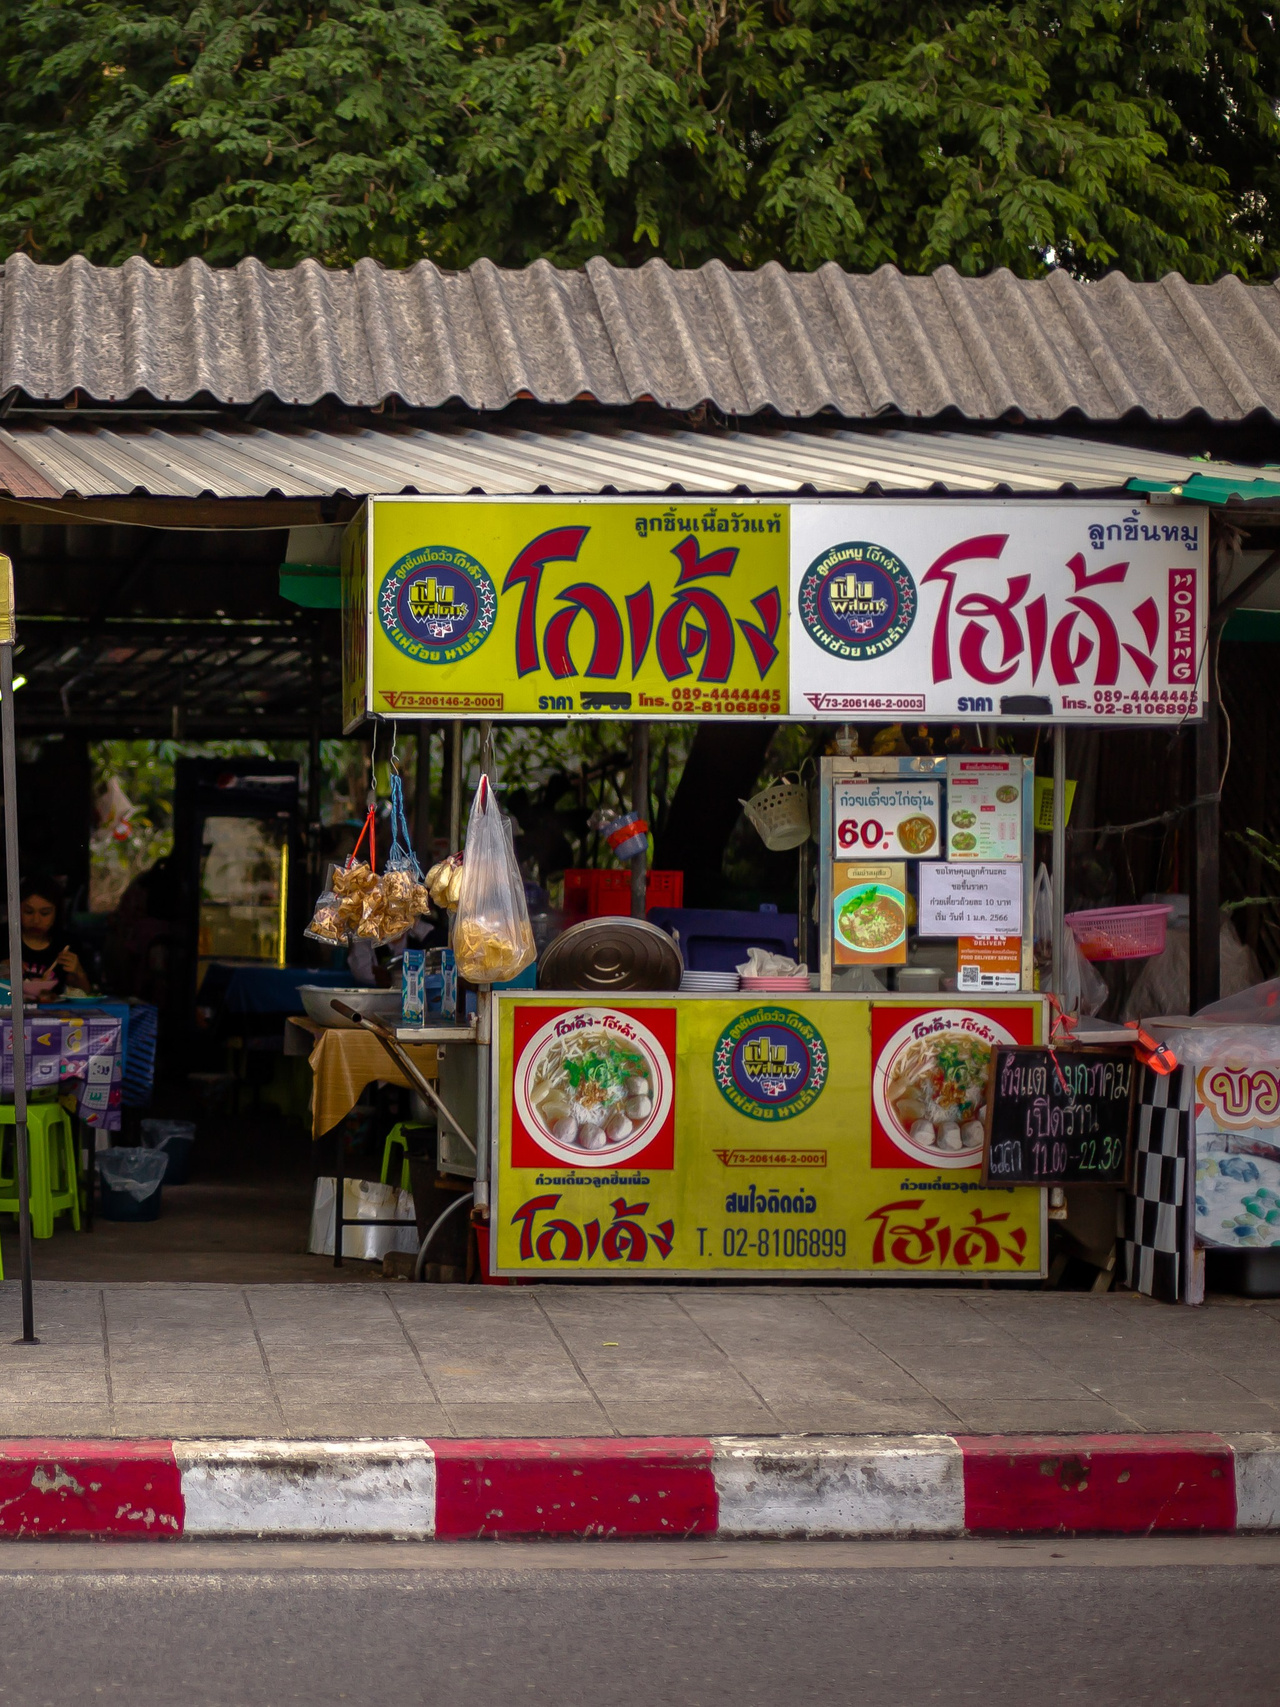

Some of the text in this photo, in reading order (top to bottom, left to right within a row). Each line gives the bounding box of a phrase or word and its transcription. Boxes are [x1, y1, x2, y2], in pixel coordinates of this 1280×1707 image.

[635, 507, 781, 538] ลูกชิ้นเนื้อวัวแท้
[1088, 509, 1198, 551] ลูกชิ้นหมู
[1173, 574, 1193, 680] HODENG
[672, 687, 781, 701] 089-4444445
[1093, 690, 1198, 702] 089-4444445
[538, 696, 573, 711] ราคา
[672, 701, 781, 714] 02-8106899
[825, 698, 923, 709] 73-206146-2-0003
[957, 697, 993, 712] ราคา
[1093, 703, 1198, 715] 02-8106899
[725, 1184, 817, 1214] สนใจติดต่อ
[696, 1228, 847, 1258] T. 02-8106899
